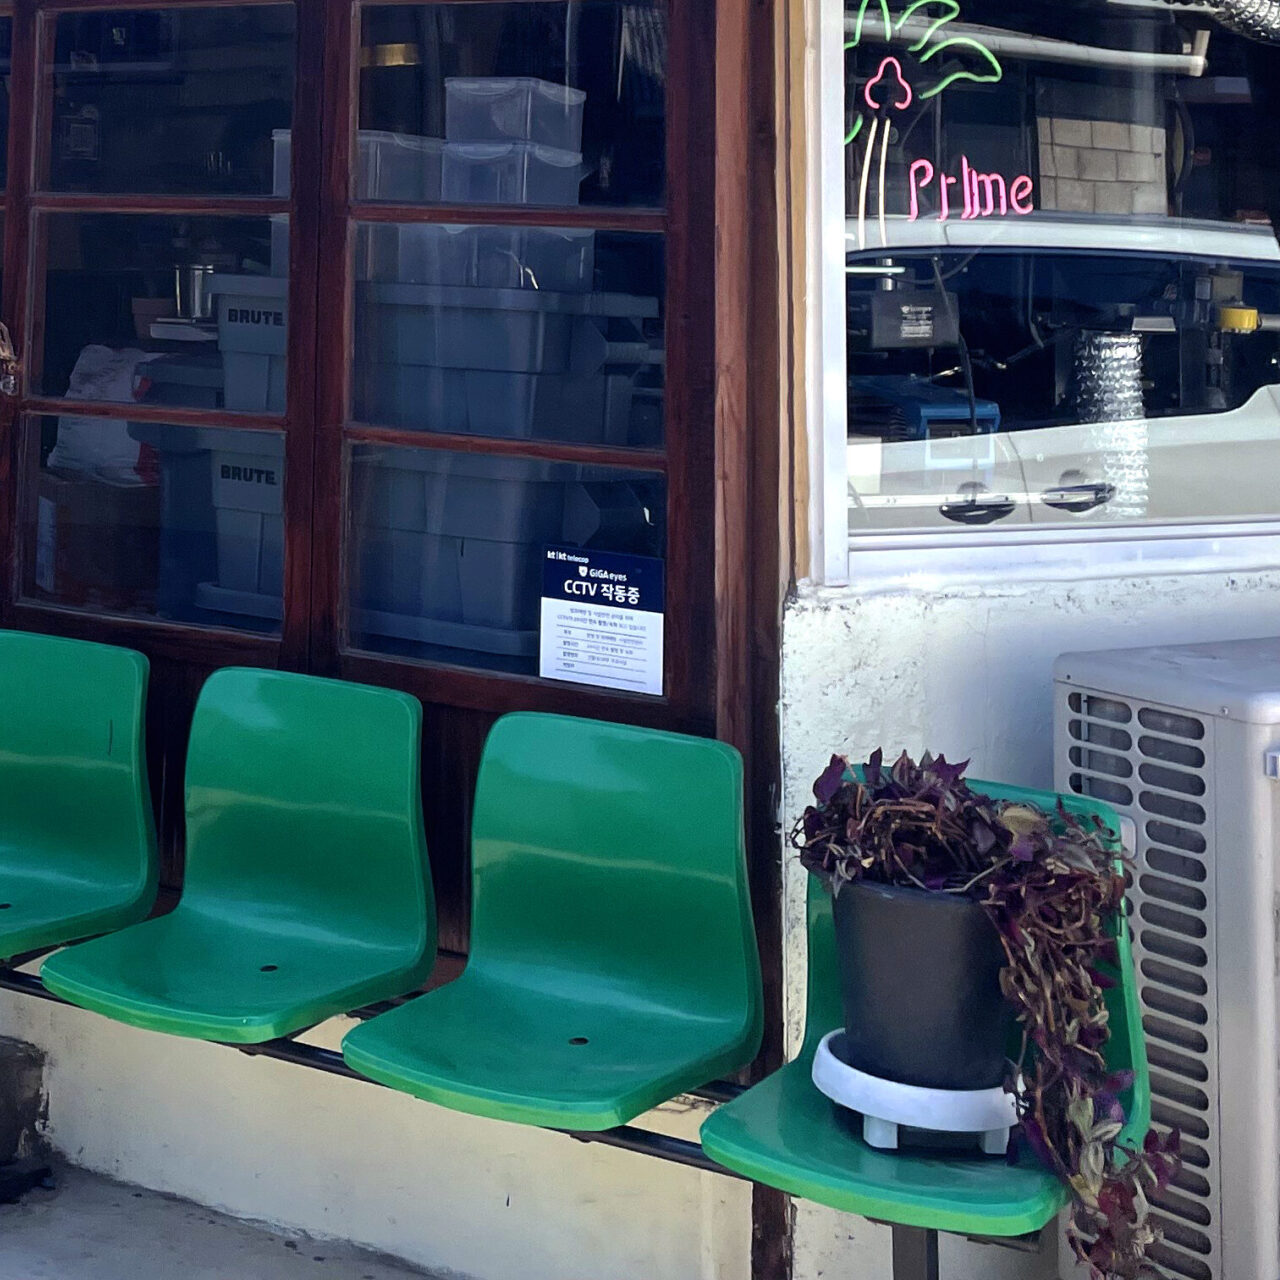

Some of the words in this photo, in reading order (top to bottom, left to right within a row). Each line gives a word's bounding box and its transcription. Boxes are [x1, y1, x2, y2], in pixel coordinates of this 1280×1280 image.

[228, 308, 285, 326] BRUTE
[221, 464, 277, 486] BRUTE
[564, 580, 597, 596] CCTV
[601, 584, 640, 604] 작동중
